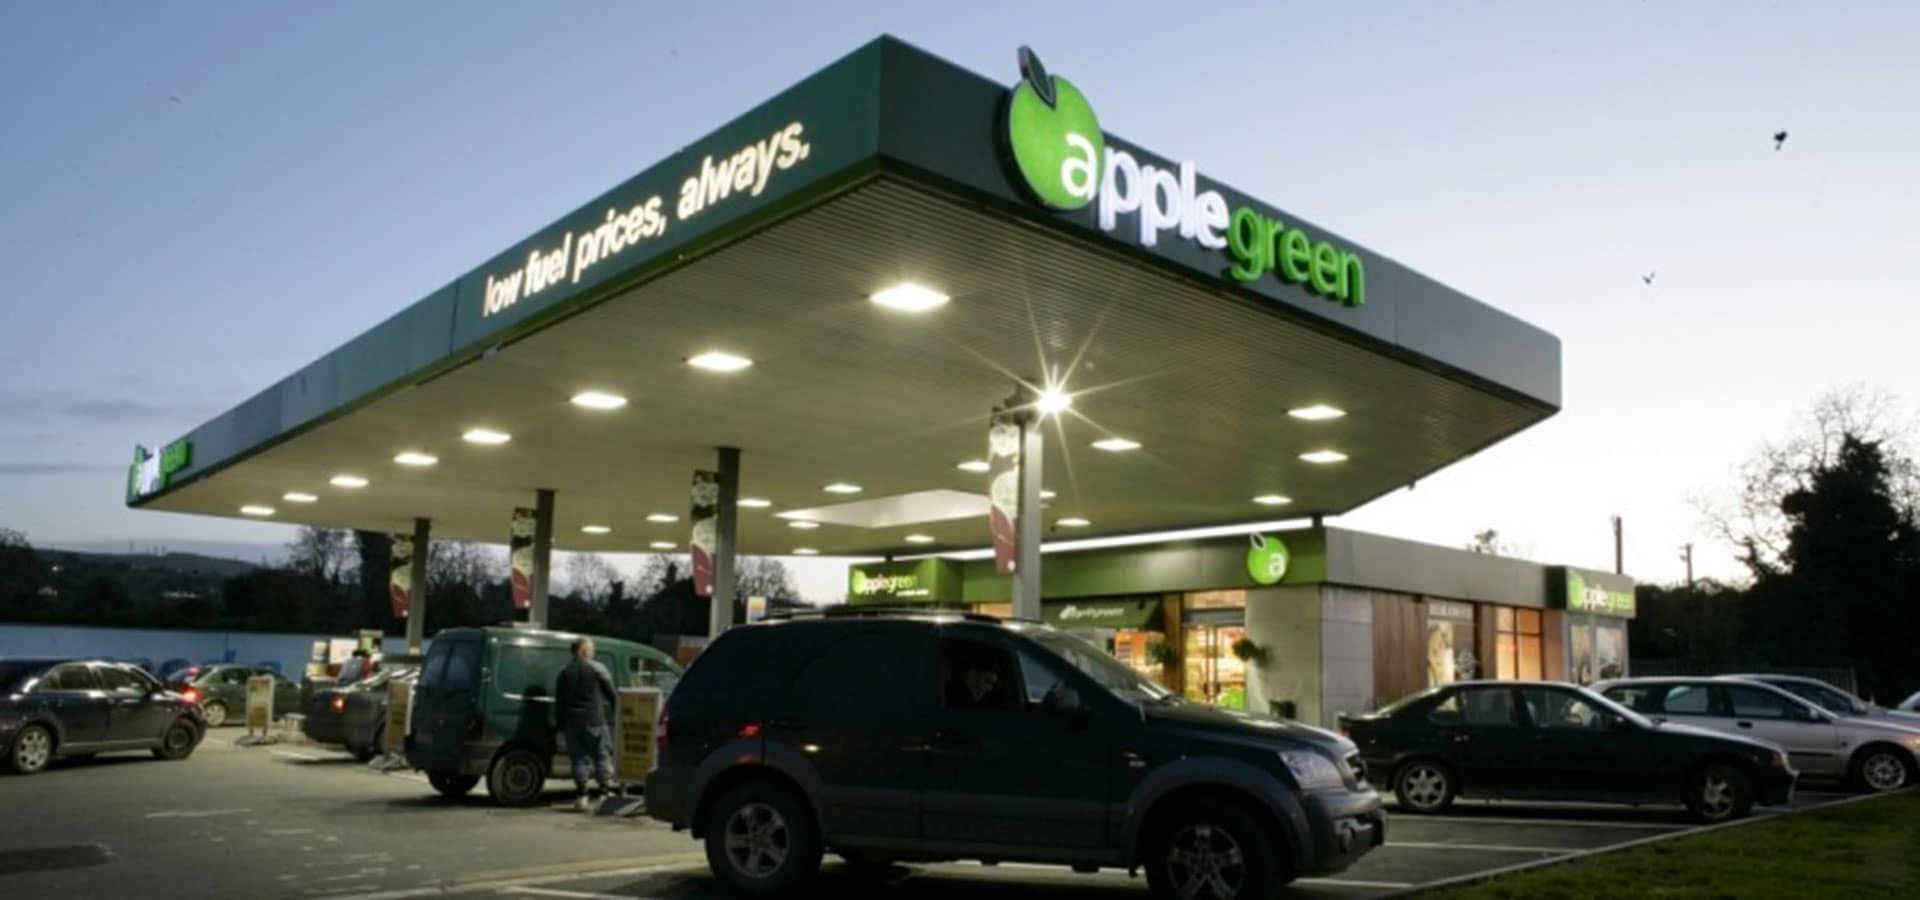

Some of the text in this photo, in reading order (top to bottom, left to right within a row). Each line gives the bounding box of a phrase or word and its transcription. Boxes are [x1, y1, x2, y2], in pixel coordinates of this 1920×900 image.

[483, 122, 810, 317] low fuel prices, always.
